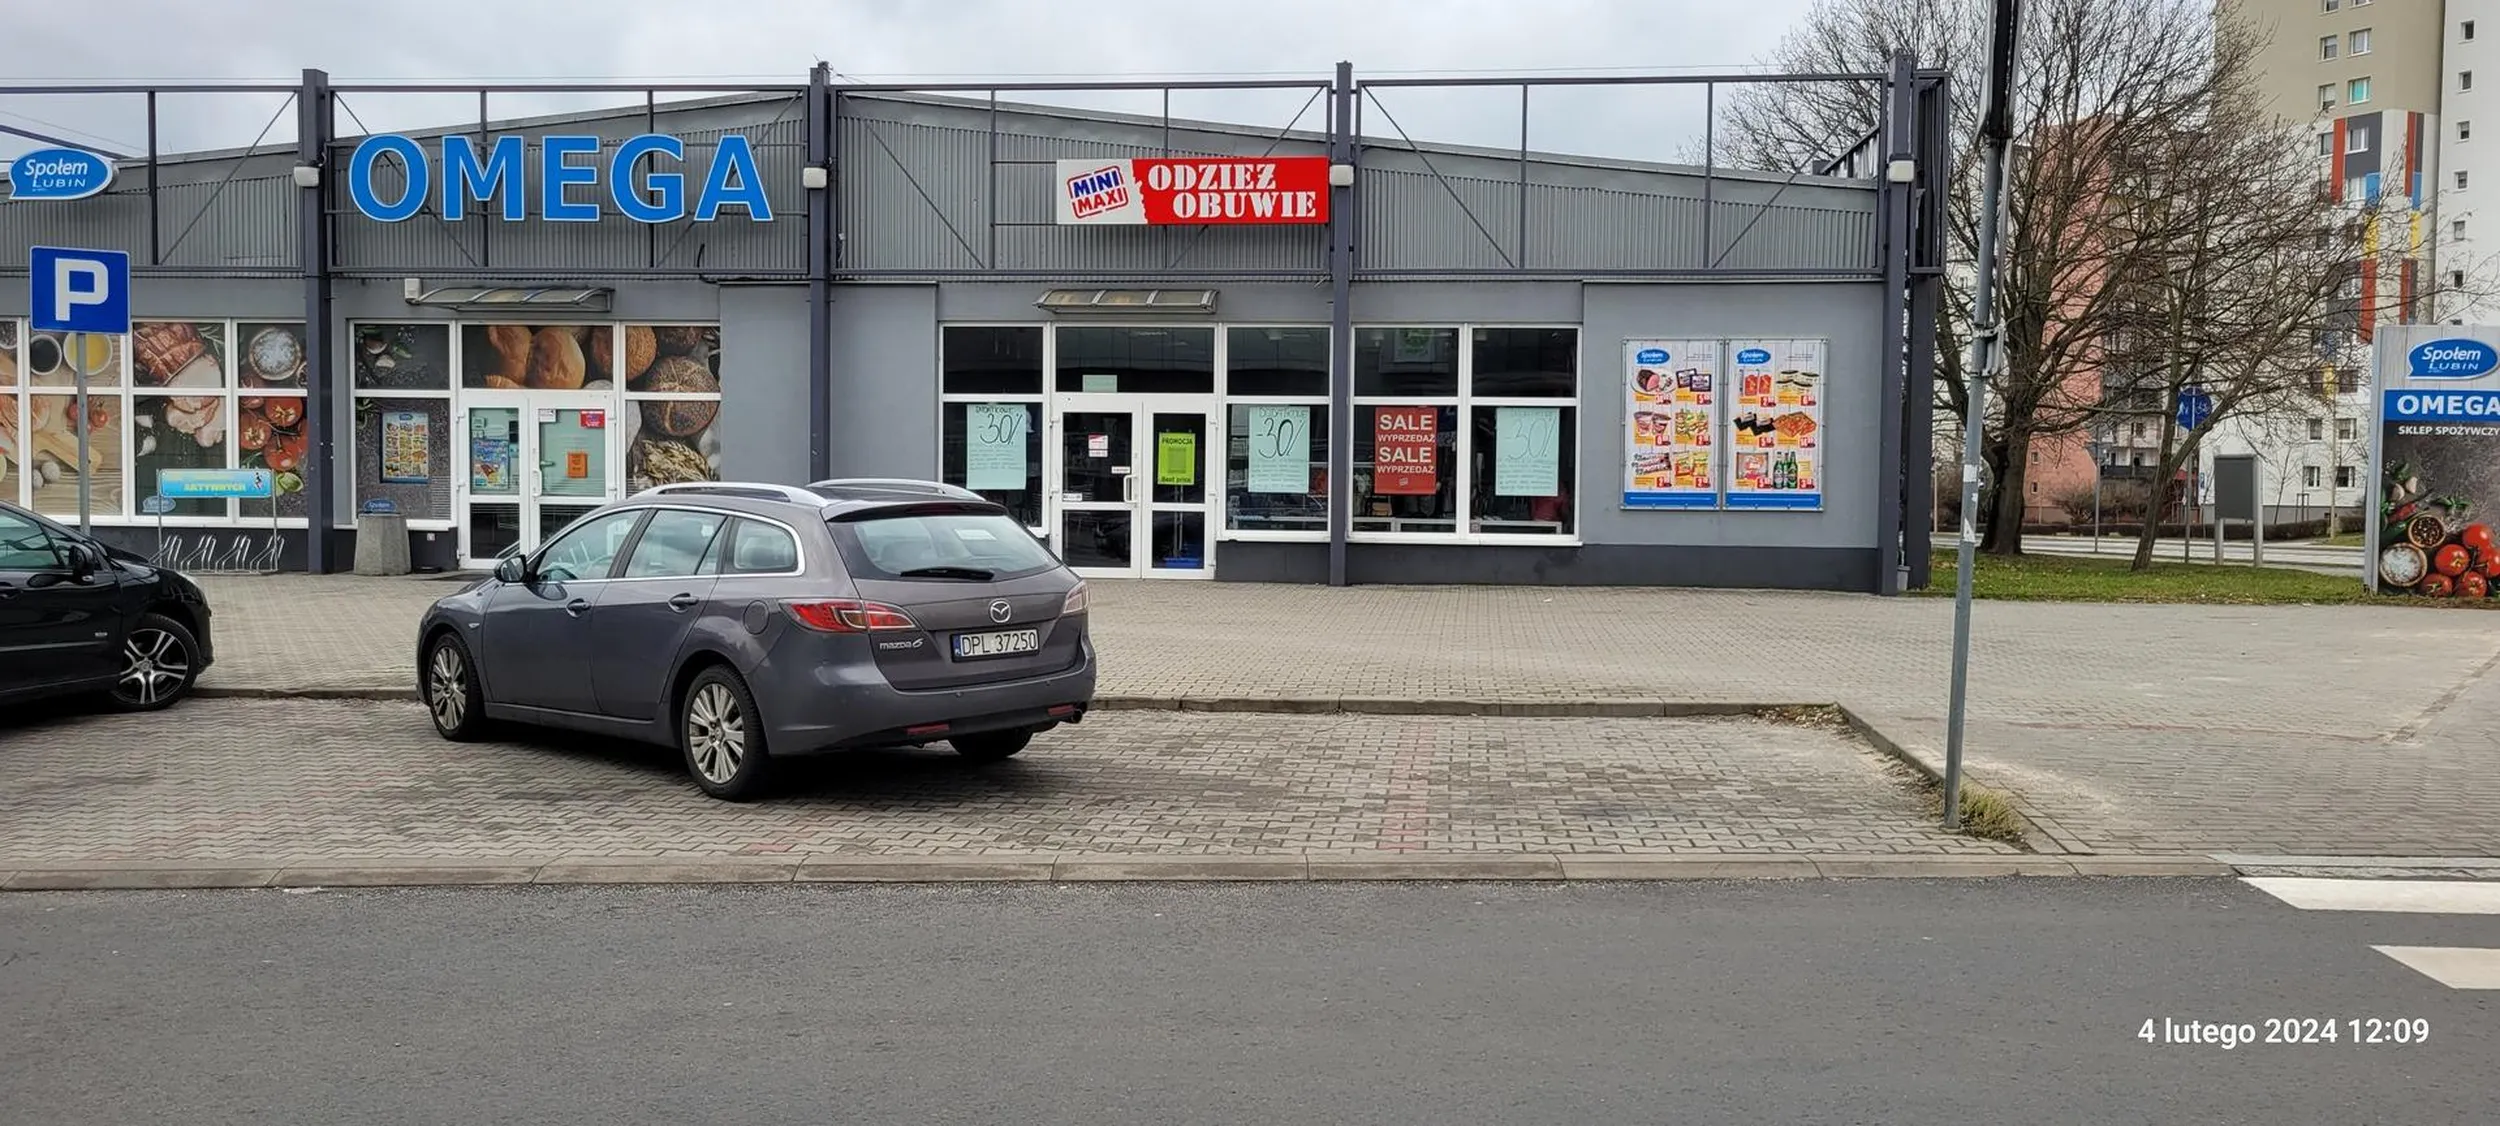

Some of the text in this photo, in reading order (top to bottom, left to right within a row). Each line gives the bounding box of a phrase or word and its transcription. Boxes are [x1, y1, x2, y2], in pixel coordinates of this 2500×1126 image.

[24, 158, 89, 179] Społem
[348, 134, 773, 223] OMEGA
[32, 178, 86, 188] LUBIN
[1071, 170, 1121, 198] MINI
[1077, 186, 1126, 213] MAXI
[1172, 191, 1317, 219] OBUWIE
[55, 257, 109, 322] P
[2421, 346, 2481, 362] Społem
[2428, 362, 2479, 370] LUBIN
[2396, 395, 2500, 416] OMEGA
[1379, 414, 1433, 430] SALE
[2397, 423, 2500, 436] SKLEP SPOŻYWCZY
[1161, 437, 1193, 445] PROMOCJA
[1379, 447, 1432, 463] SALE
[962, 631, 1037, 656] DPL 37250
